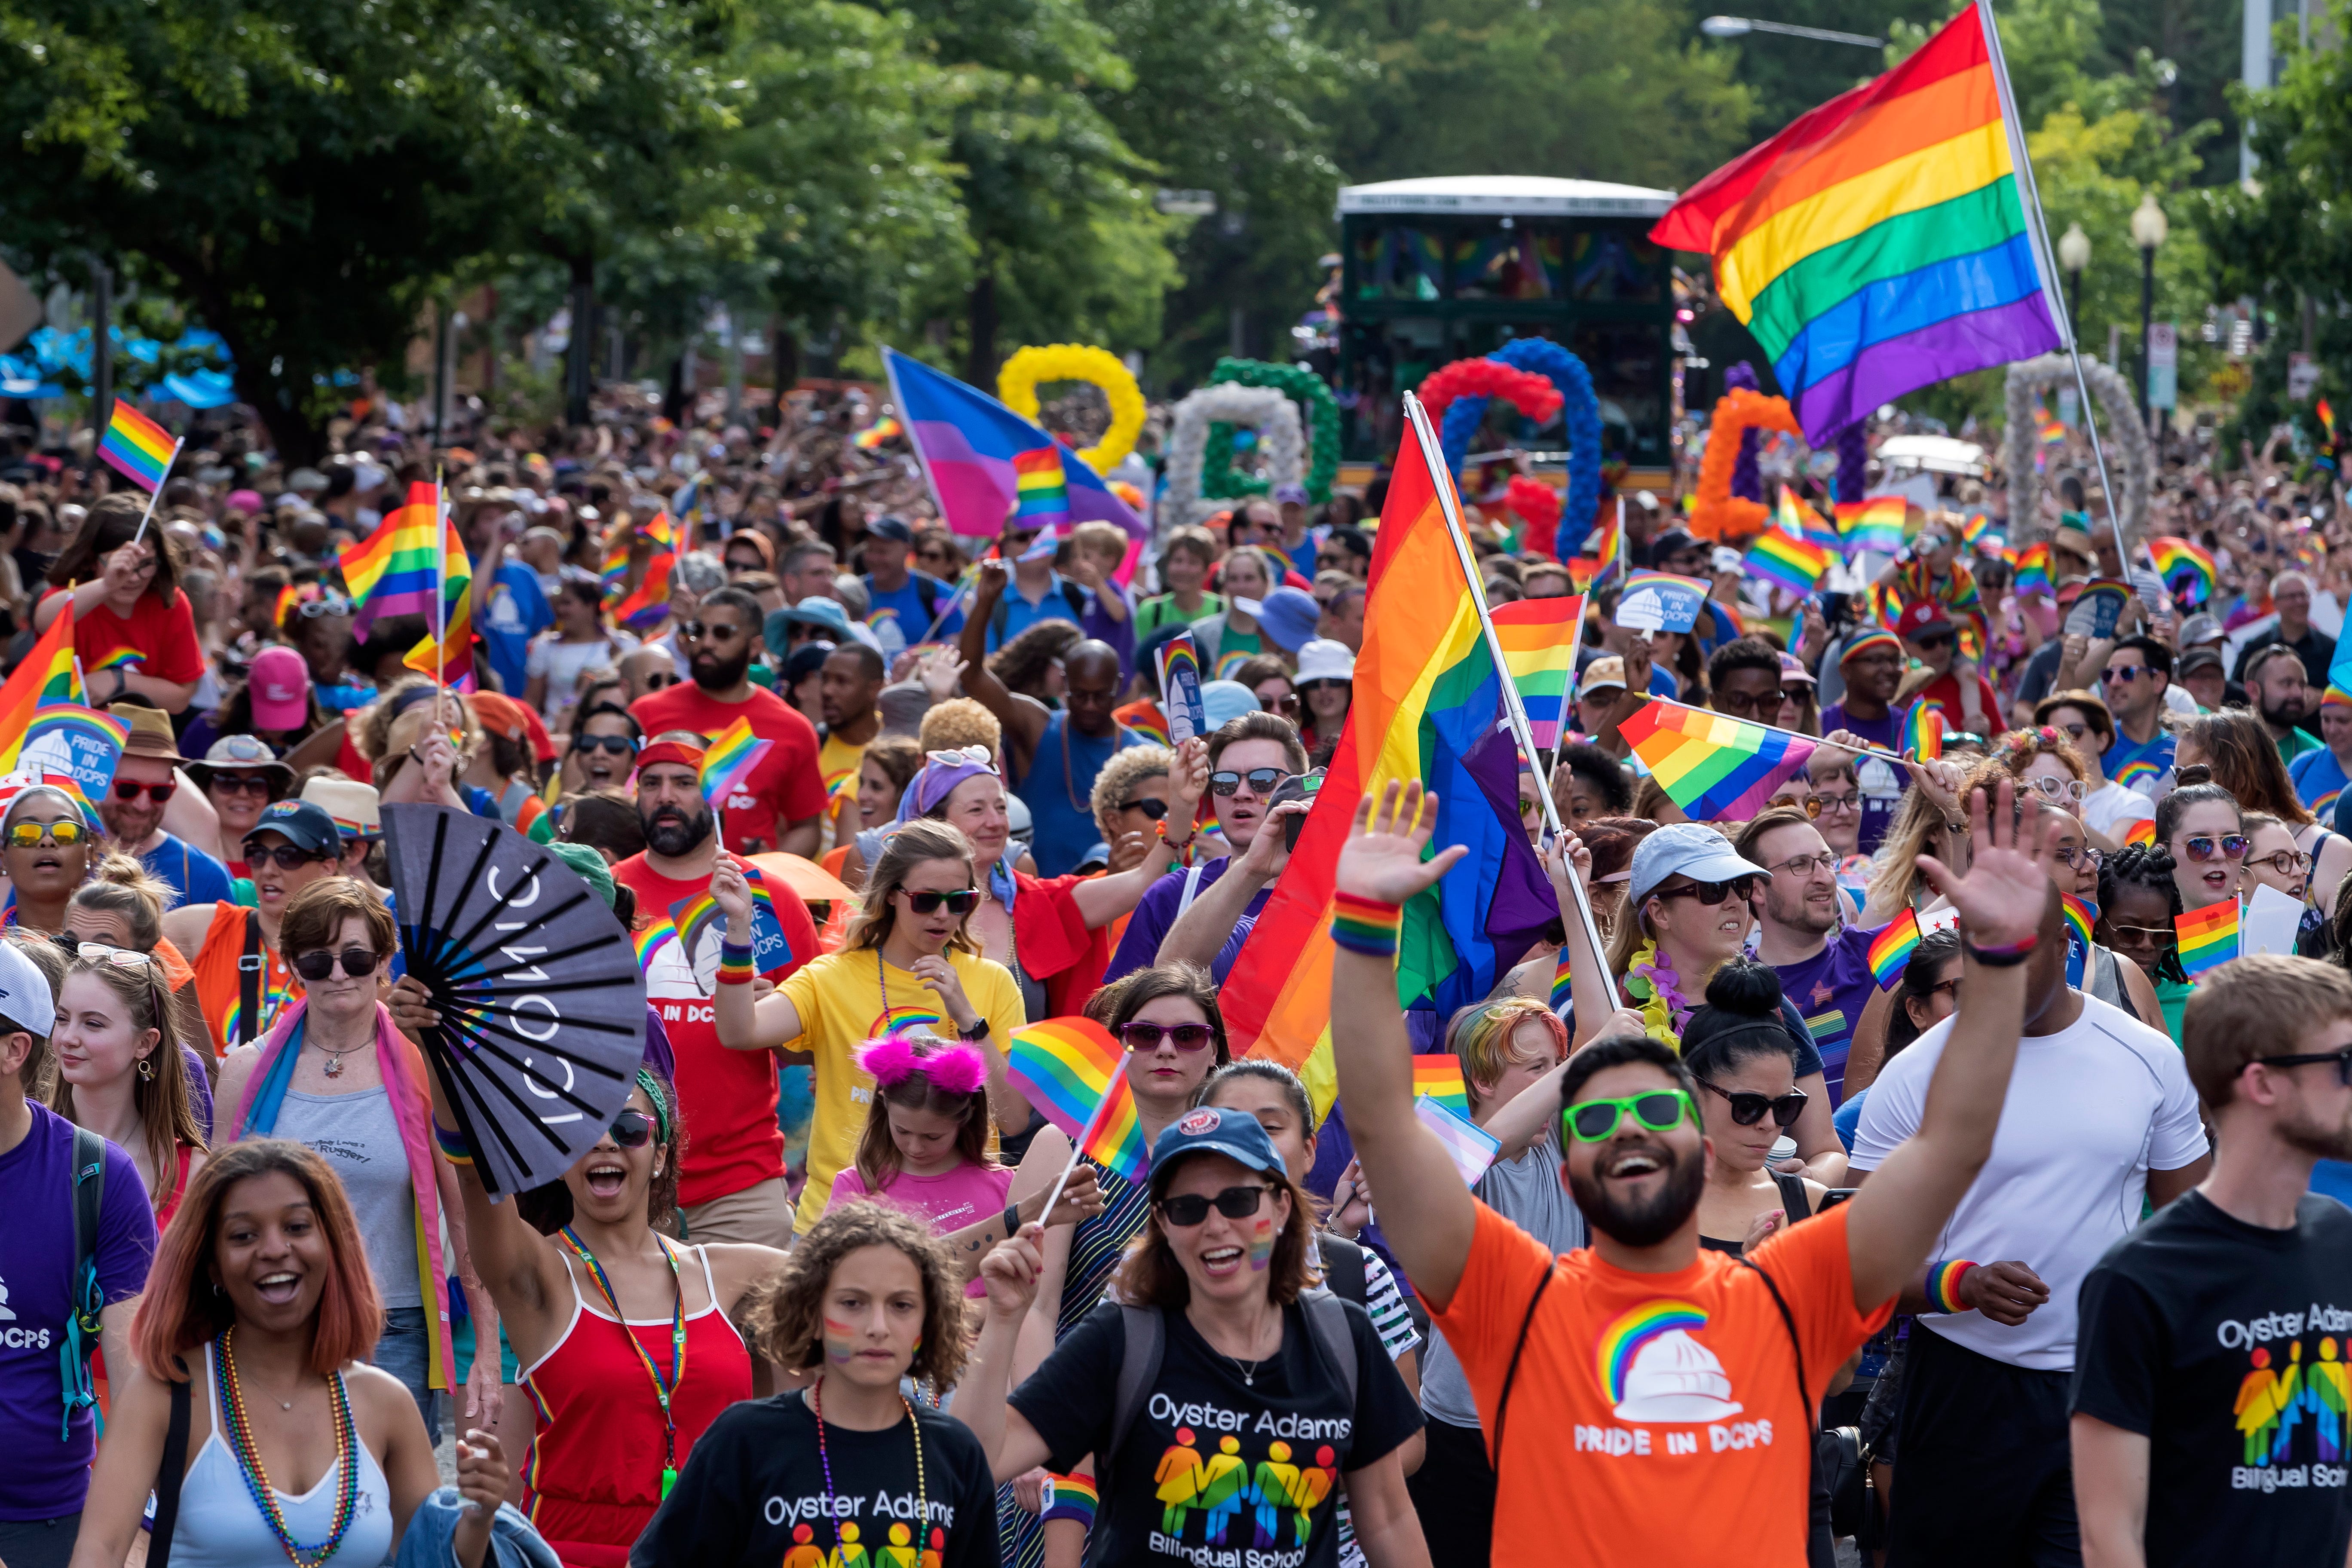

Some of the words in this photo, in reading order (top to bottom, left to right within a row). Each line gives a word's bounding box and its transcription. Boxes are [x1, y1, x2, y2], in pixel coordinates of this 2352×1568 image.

[1663, 609, 1693, 623] DCPS
[1670, 601, 1684, 611] IN
[71, 735, 110, 757] PRIDE
[81, 753, 99, 769] IN
[72, 766, 109, 787] DCPS
[663, 1004, 682, 1022] IN
[686, 1004, 716, 1023] DC
[675, 1330, 685, 1343] TD
[2217, 1311, 2306, 1352] Oyster
[1148, 1393, 1250, 1432] Oyster
[1254, 1409, 1352, 1440] Adams
[1574, 1424, 1652, 1457] PRIDE
[1666, 1431, 1698, 1455] IN
[1707, 1418, 1773, 1454] DCPS
[764, 1491, 866, 1528] Oyster
[1148, 1530, 1241, 1568] Bilingual
[1246, 1543, 1307, 1568] School
